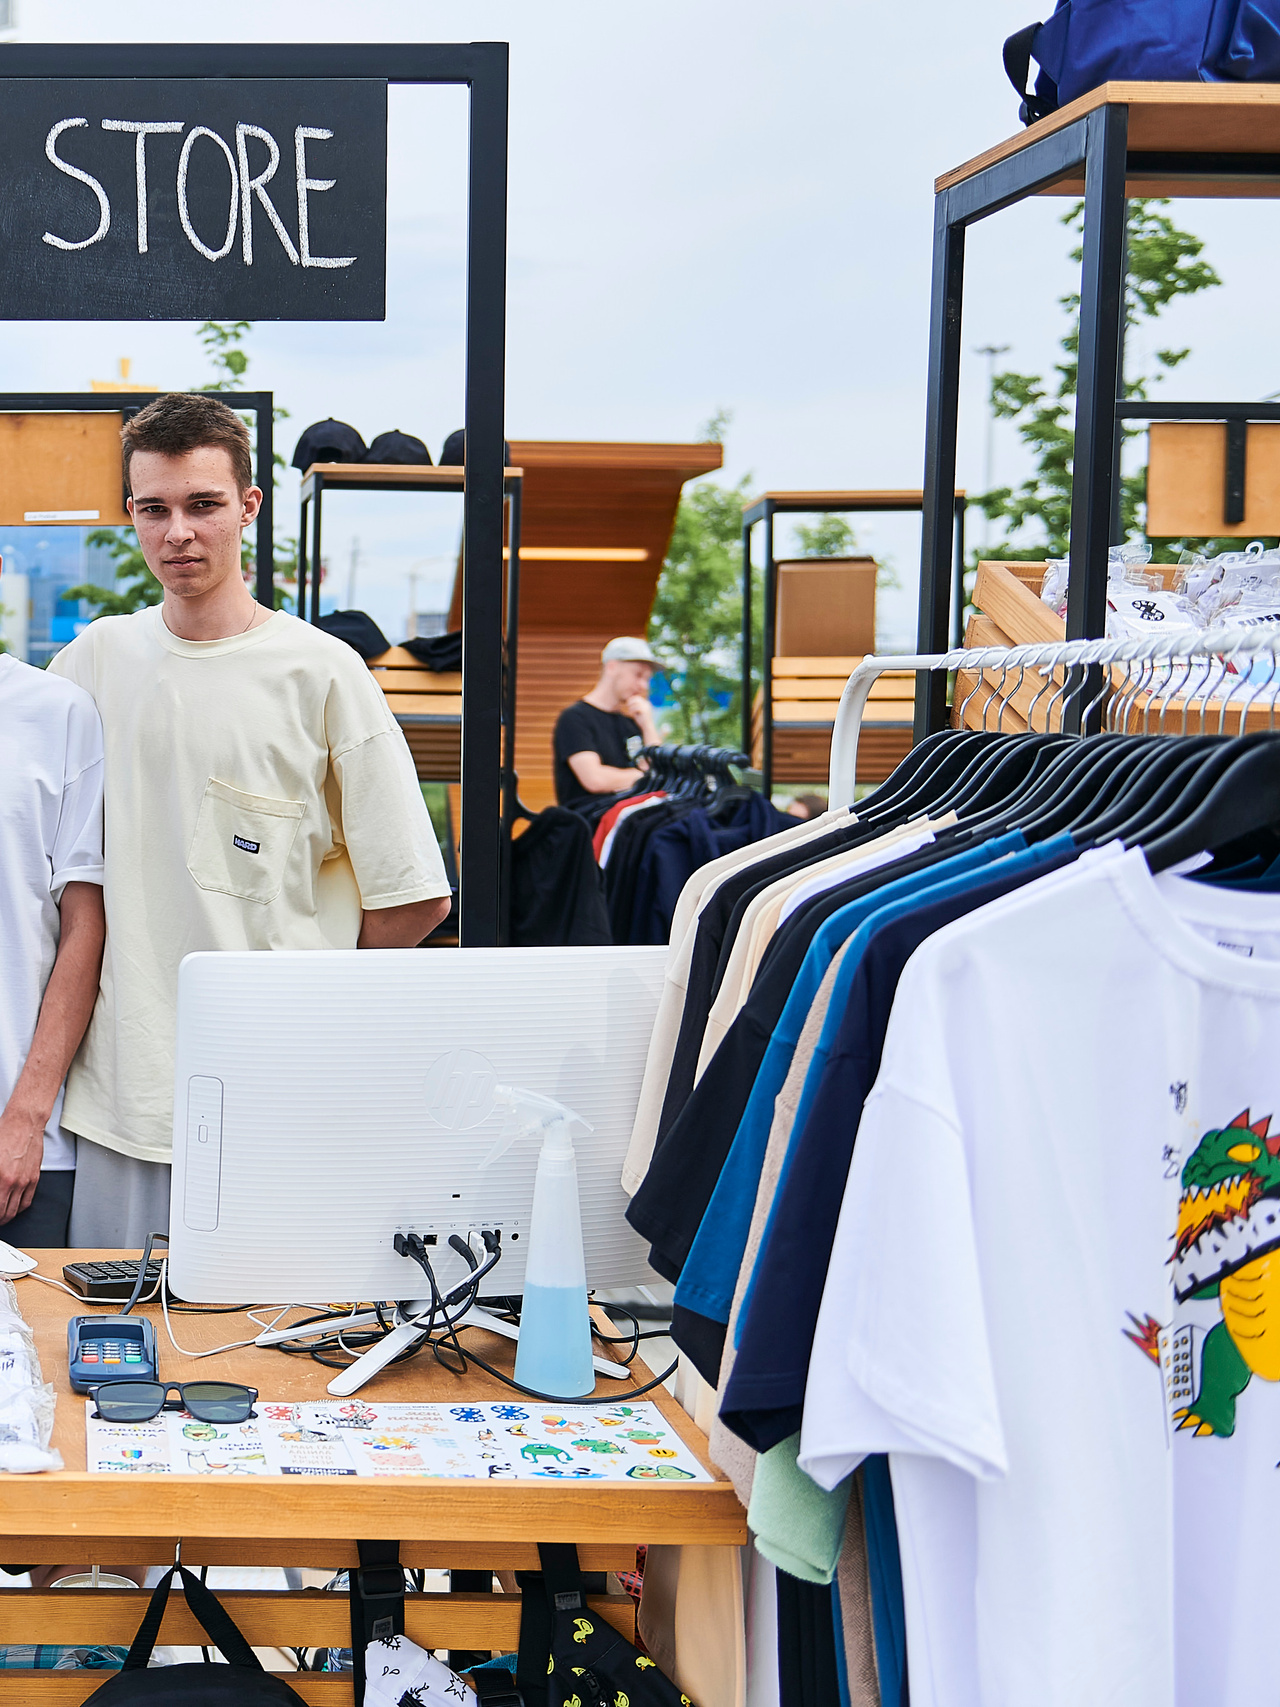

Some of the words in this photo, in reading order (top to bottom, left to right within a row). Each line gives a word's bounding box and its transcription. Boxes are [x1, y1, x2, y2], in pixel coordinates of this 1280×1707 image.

[42, 117, 358, 269] STORE
[234, 837, 258, 851] HARD
[431, 1049, 494, 1131] hp
